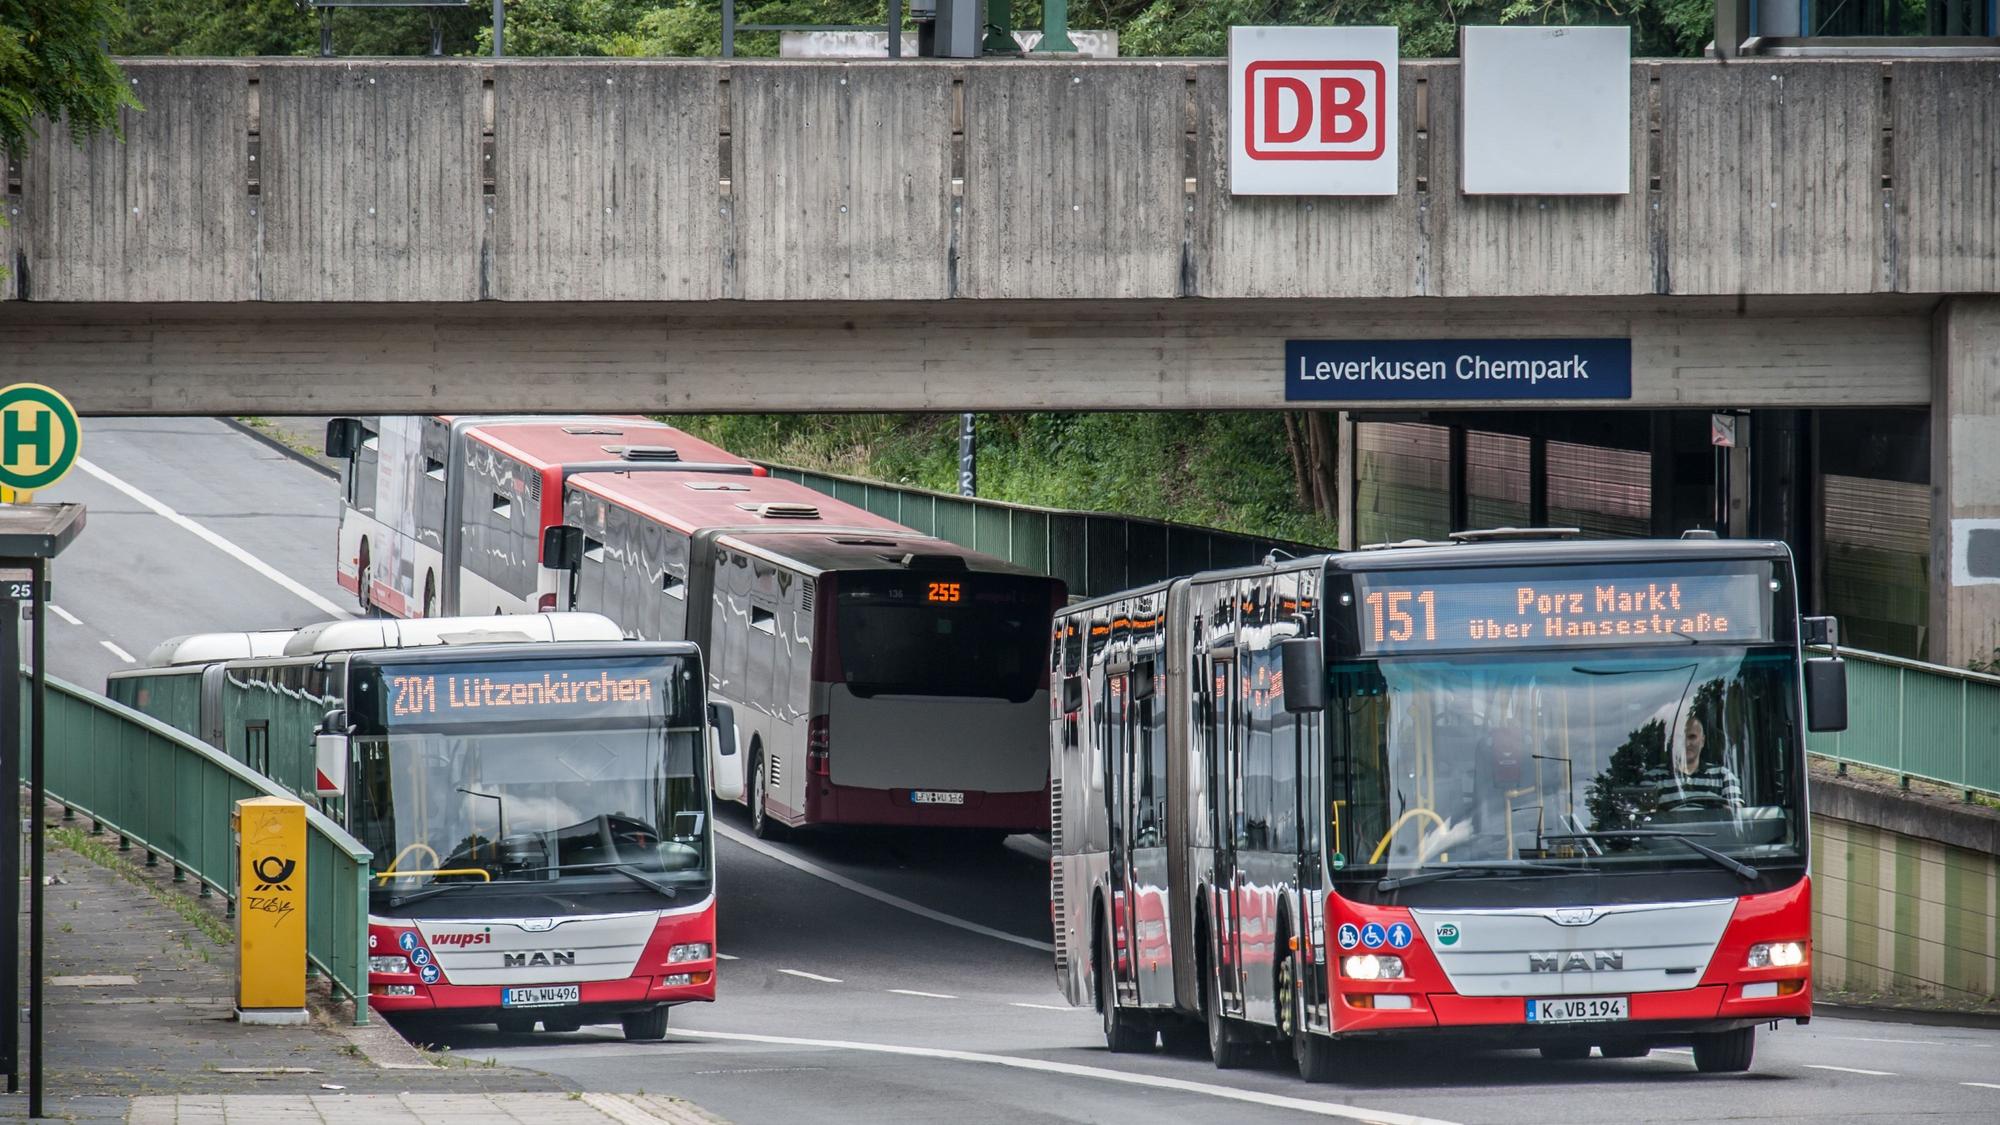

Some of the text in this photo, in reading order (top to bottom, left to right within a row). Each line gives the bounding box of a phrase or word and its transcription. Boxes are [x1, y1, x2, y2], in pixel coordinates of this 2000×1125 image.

[1264, 77, 1368, 144] DB
[1300, 354, 1589, 385] Leverkusen Chempark
[4, 411, 50, 465] H
[928, 582, 961, 602] 255
[1517, 583, 1681, 615] Porz Markt
[1366, 590, 1436, 642] 151
[1469, 613, 1728, 640] über Hansestraße
[393, 672, 651, 716] 201 Lützenkirchen
[432, 927, 490, 948] wupsi
[1436, 928, 1454, 936] VRS
[504, 951, 575, 967] MAN
[1529, 951, 1624, 972] MAN
[510, 988, 577, 1002] LEV WU 496
[1542, 1002, 1553, 1018] K
[1565, 1001, 1586, 1017] VB
[1590, 1000, 1619, 1016] 194
